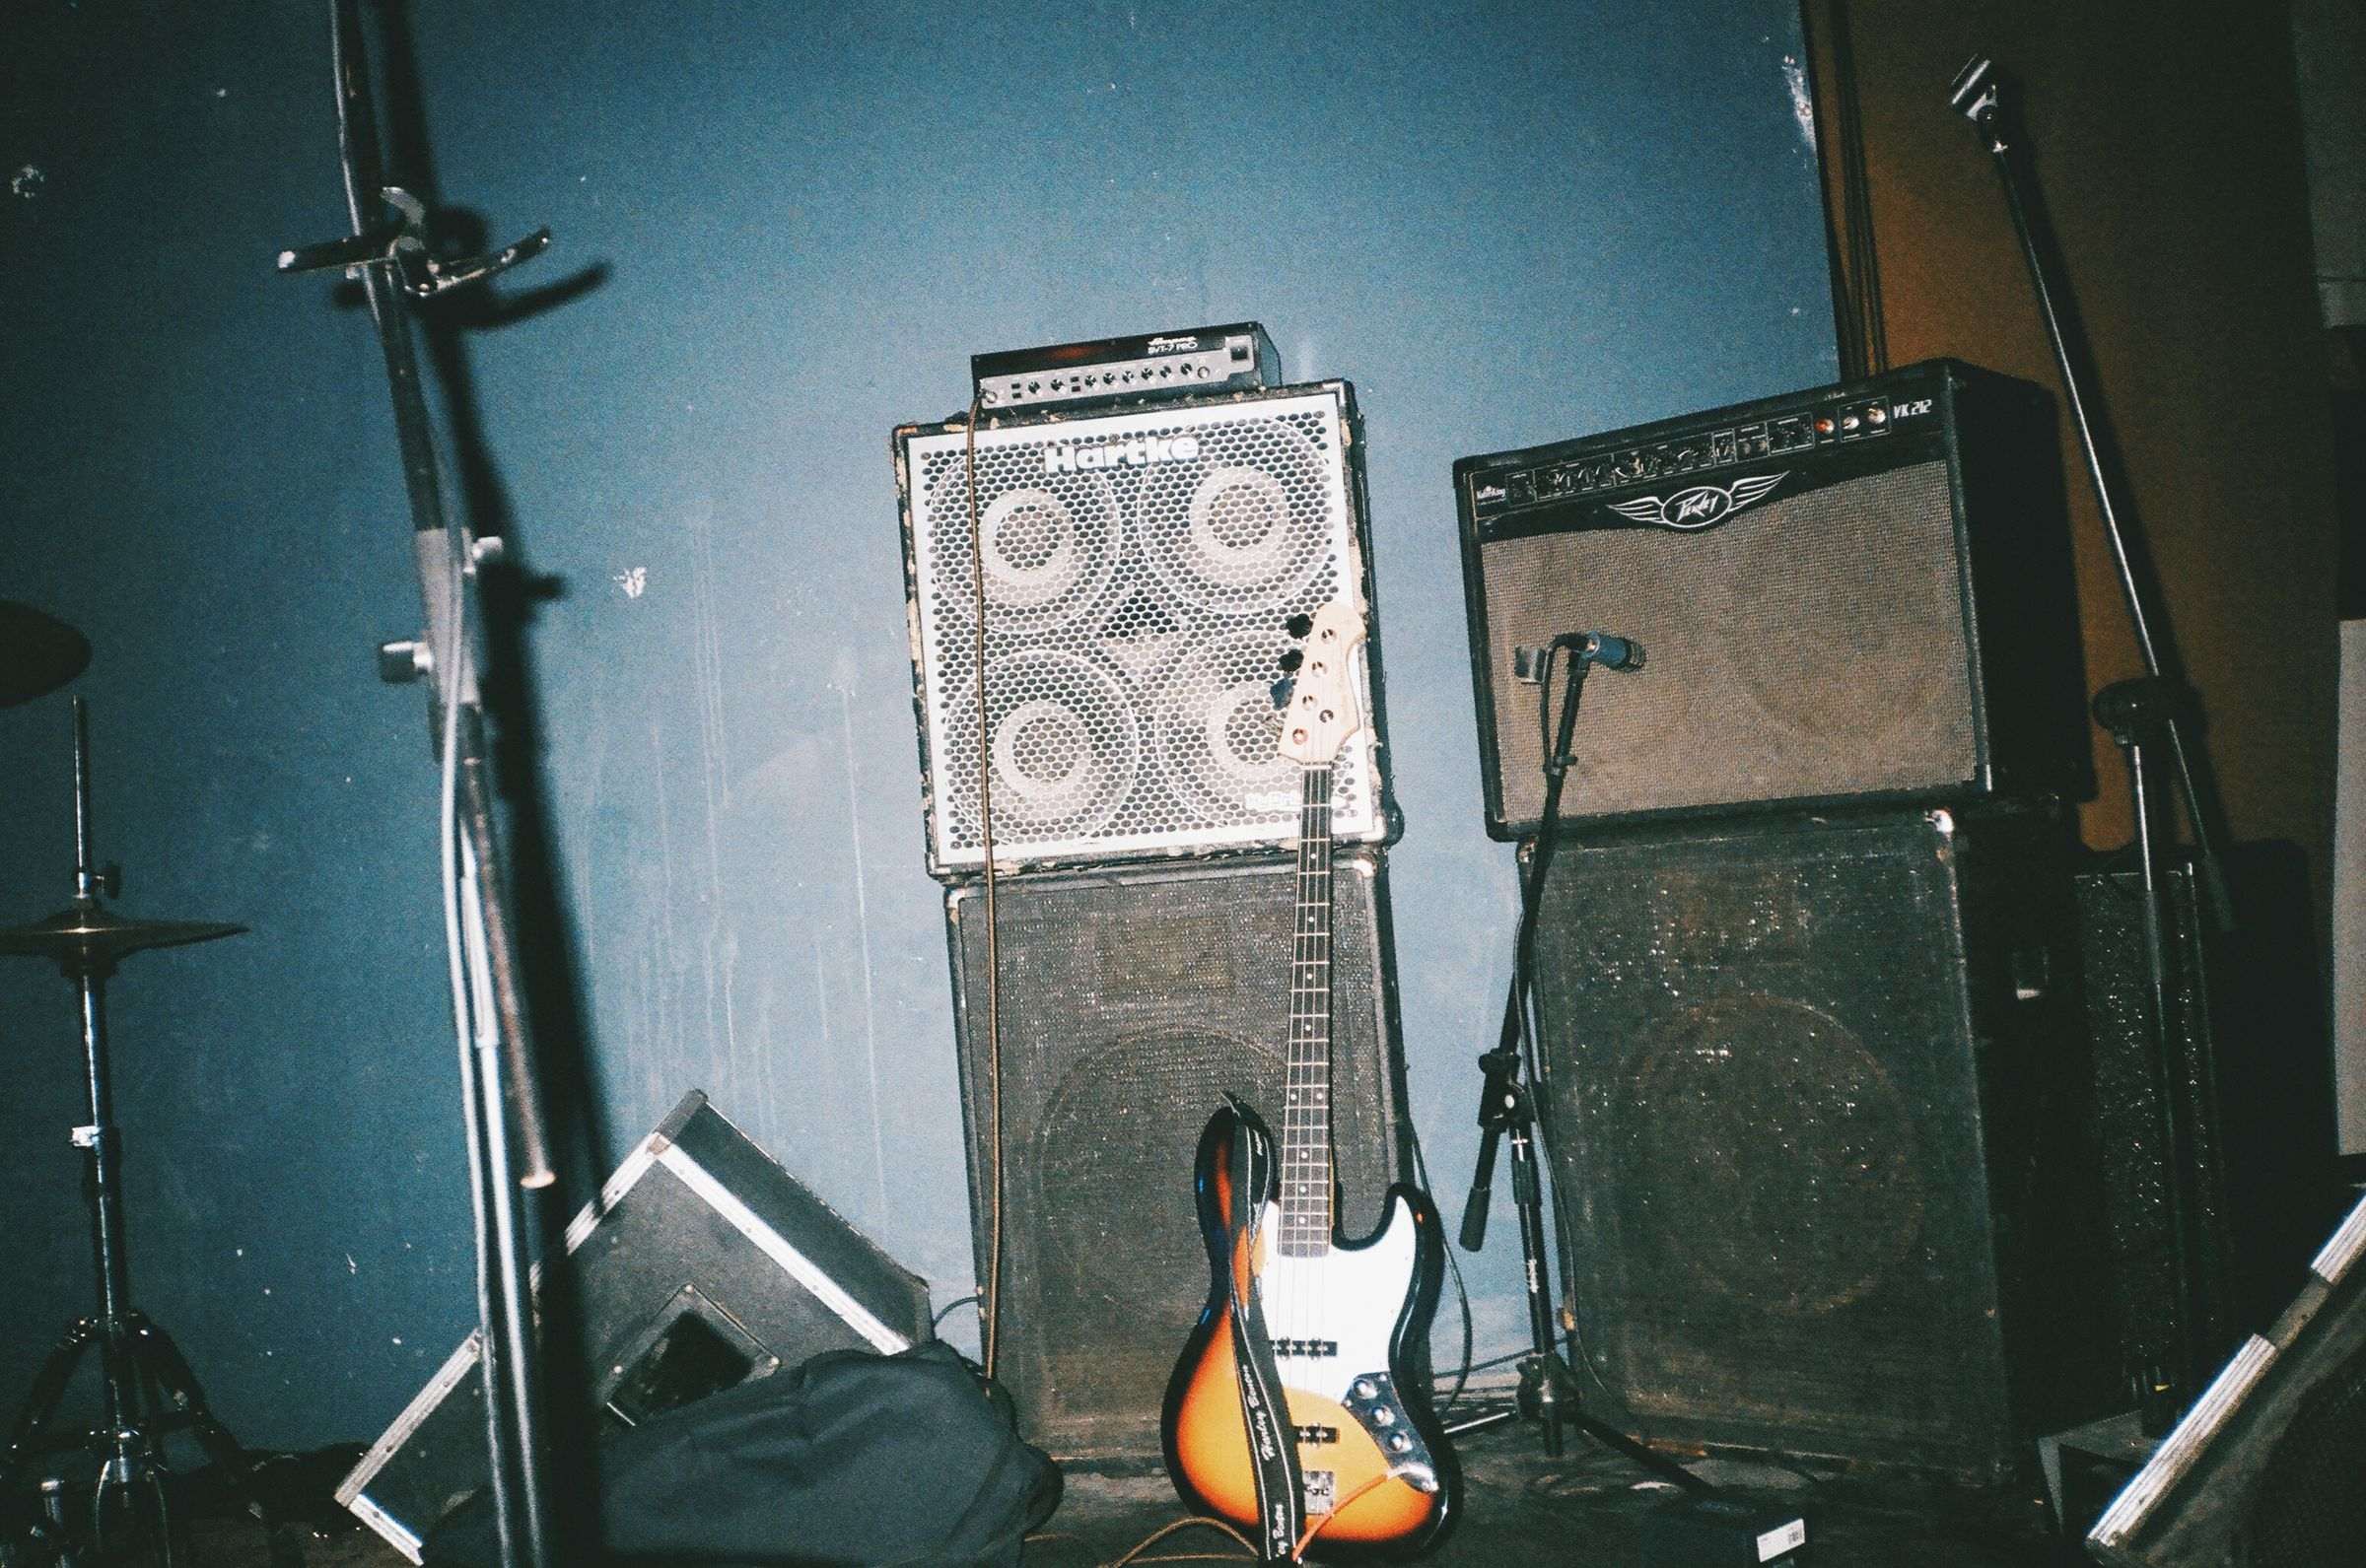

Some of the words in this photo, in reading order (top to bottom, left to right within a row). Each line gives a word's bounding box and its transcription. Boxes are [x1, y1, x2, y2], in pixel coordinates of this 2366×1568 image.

[1893, 405, 1910, 419] VK
[1911, 398, 1932, 415] 212
[1043, 435, 1200, 473] Hartke
[1241, 1364, 1261, 1408] Benton
[1254, 1409, 1277, 1462] Harley
[1272, 1503, 1286, 1540] Benton
